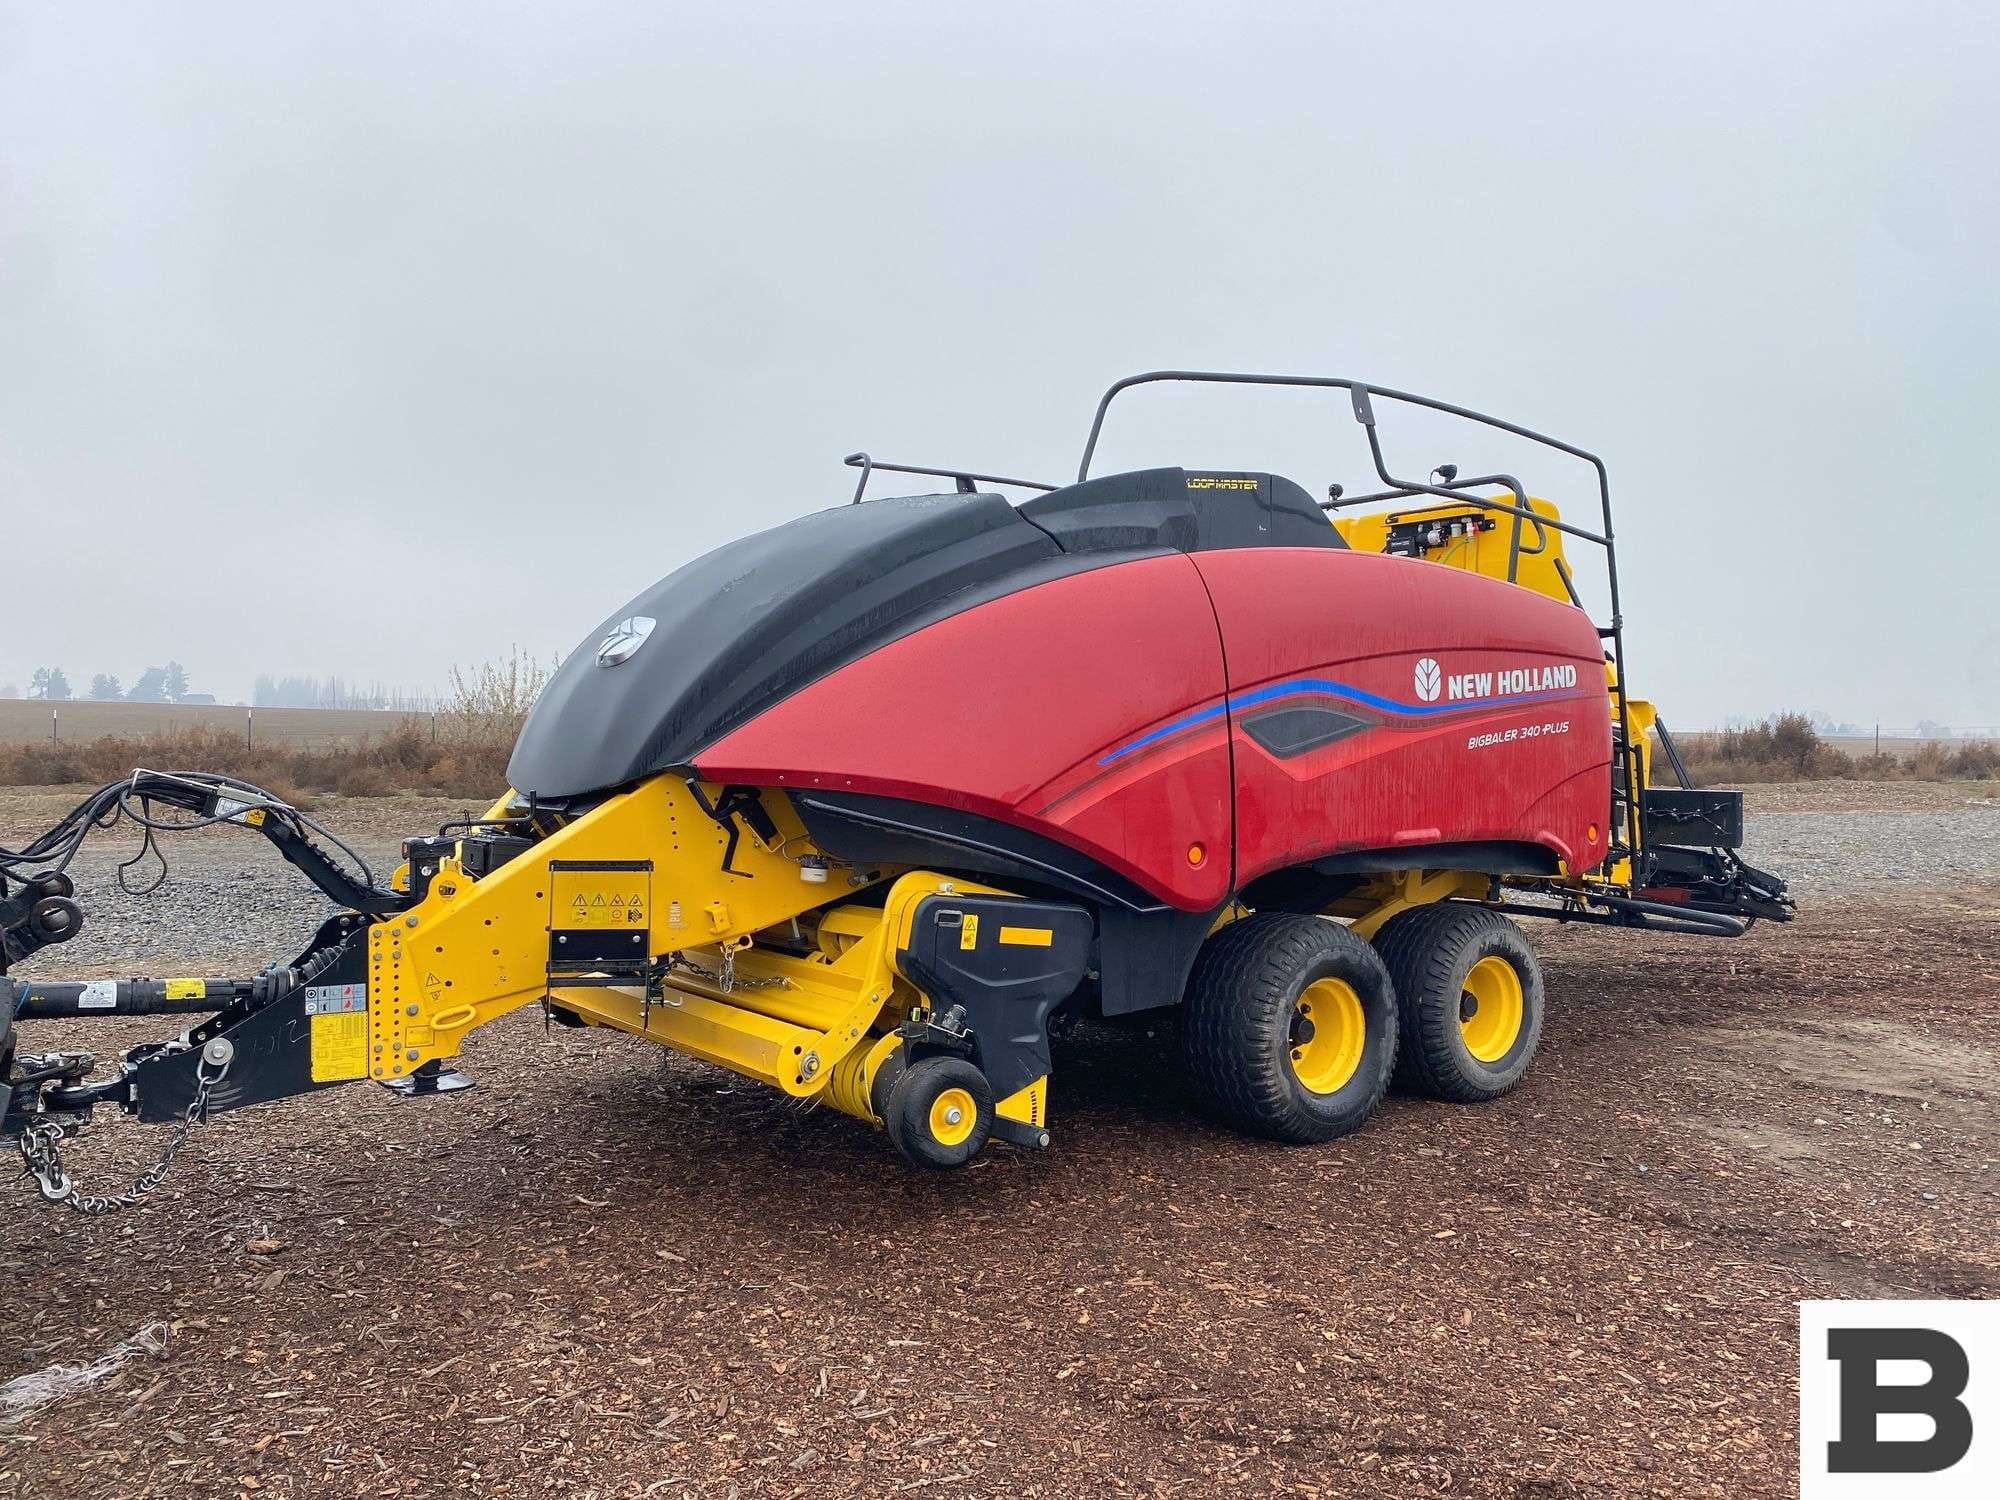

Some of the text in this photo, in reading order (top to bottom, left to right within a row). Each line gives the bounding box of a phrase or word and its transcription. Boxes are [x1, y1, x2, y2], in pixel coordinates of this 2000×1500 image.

[1448, 664, 1577, 700] NEW HOLLAND
[1467, 730, 1518, 750] BIGBALER
[1520, 724, 1541, 740] 340
